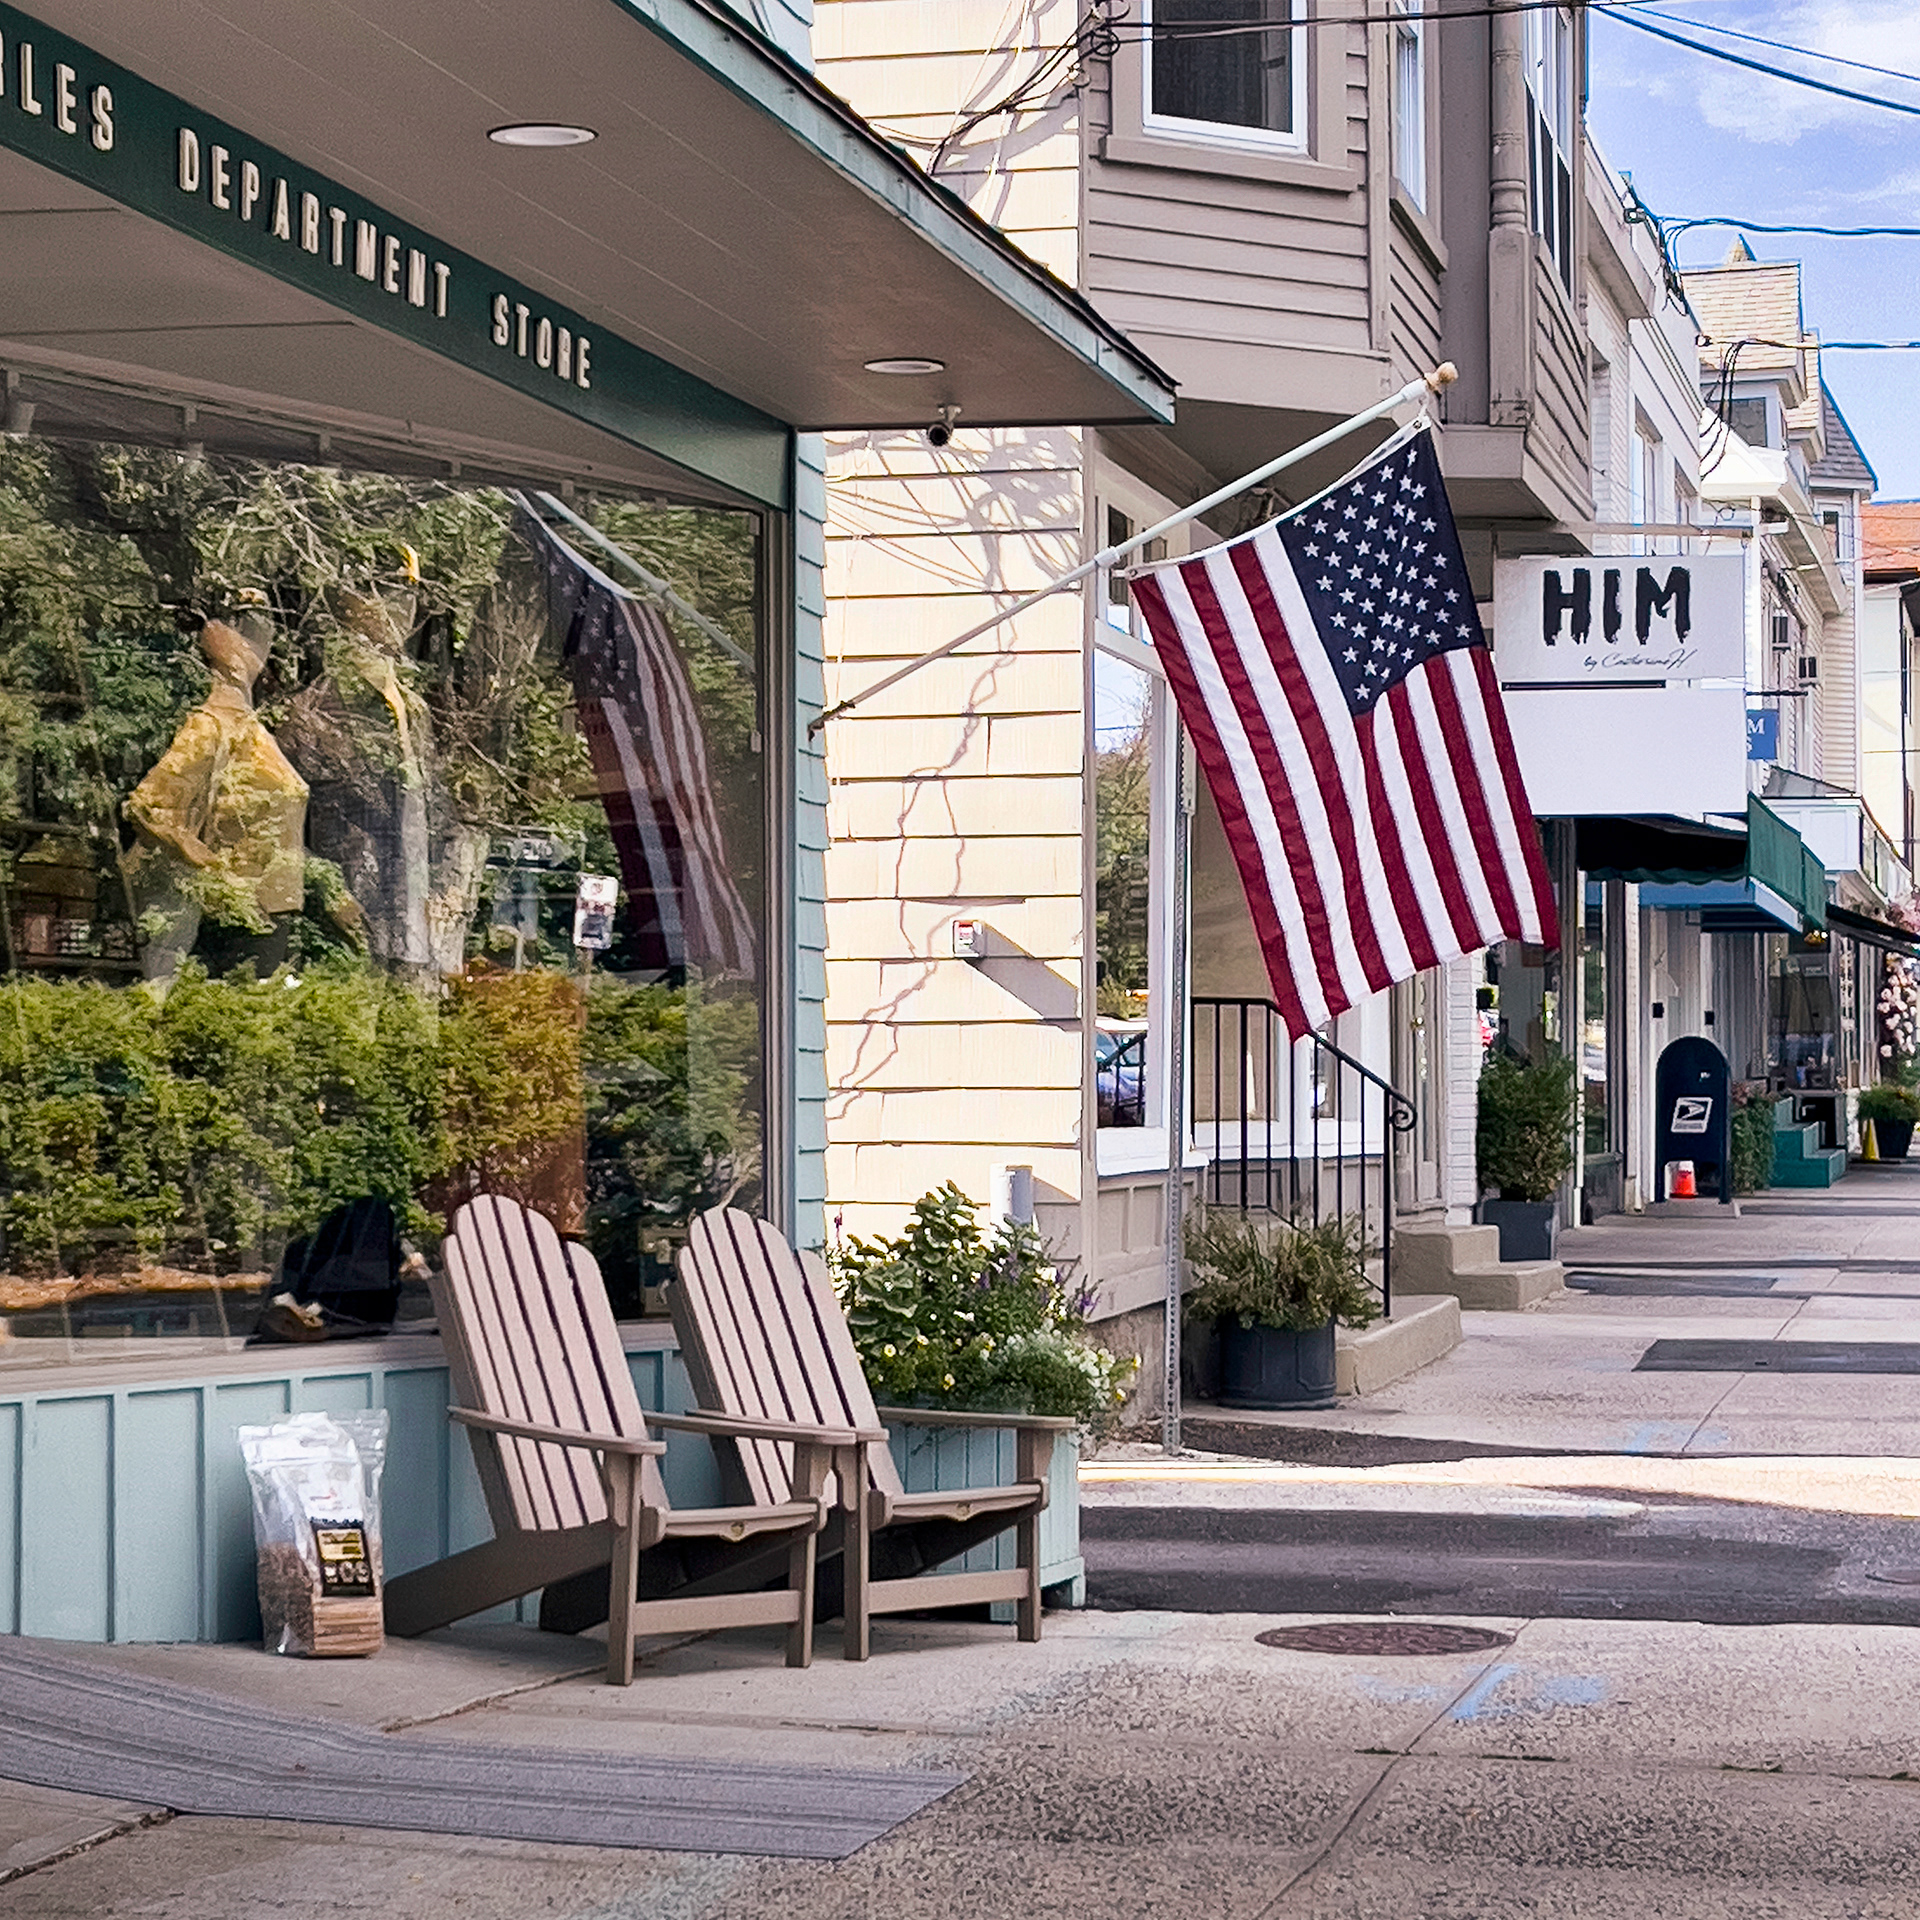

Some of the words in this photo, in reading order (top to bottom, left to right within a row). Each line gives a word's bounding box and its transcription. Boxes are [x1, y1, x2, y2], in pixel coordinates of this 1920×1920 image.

[0, 29, 114, 151] LES
[177, 127, 452, 318] DEPARTMENT
[492, 293, 591, 389] STORE
[1542, 566, 1691, 647] HIM
[1583, 655, 1598, 672] by
